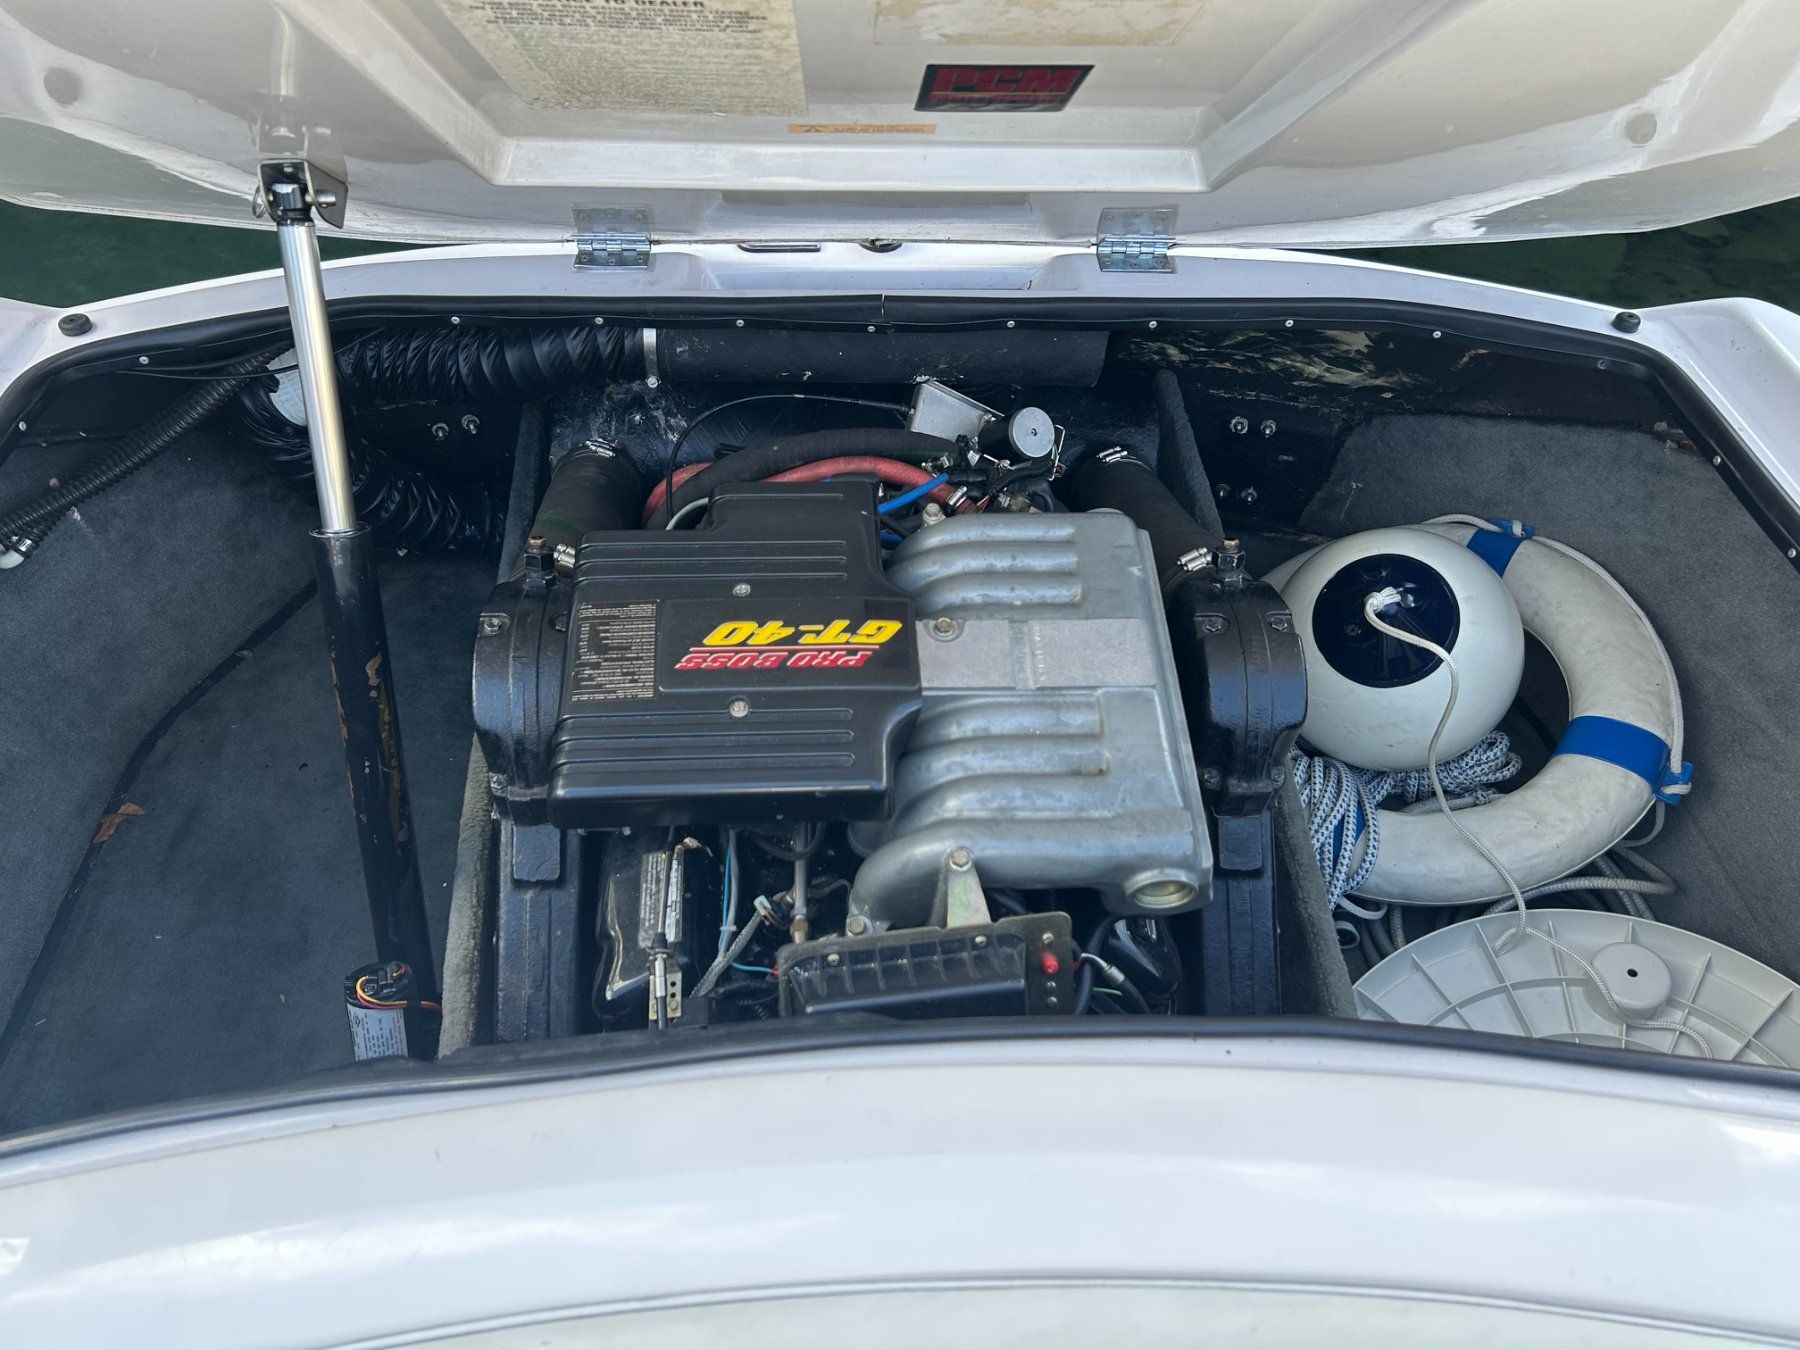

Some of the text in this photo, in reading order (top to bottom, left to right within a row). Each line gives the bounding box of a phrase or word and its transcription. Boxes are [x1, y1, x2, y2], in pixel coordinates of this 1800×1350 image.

[932, 67, 1081, 92] PCM
[702, 619, 903, 646] GT-40
[674, 651, 873, 671] PRO BOSS
